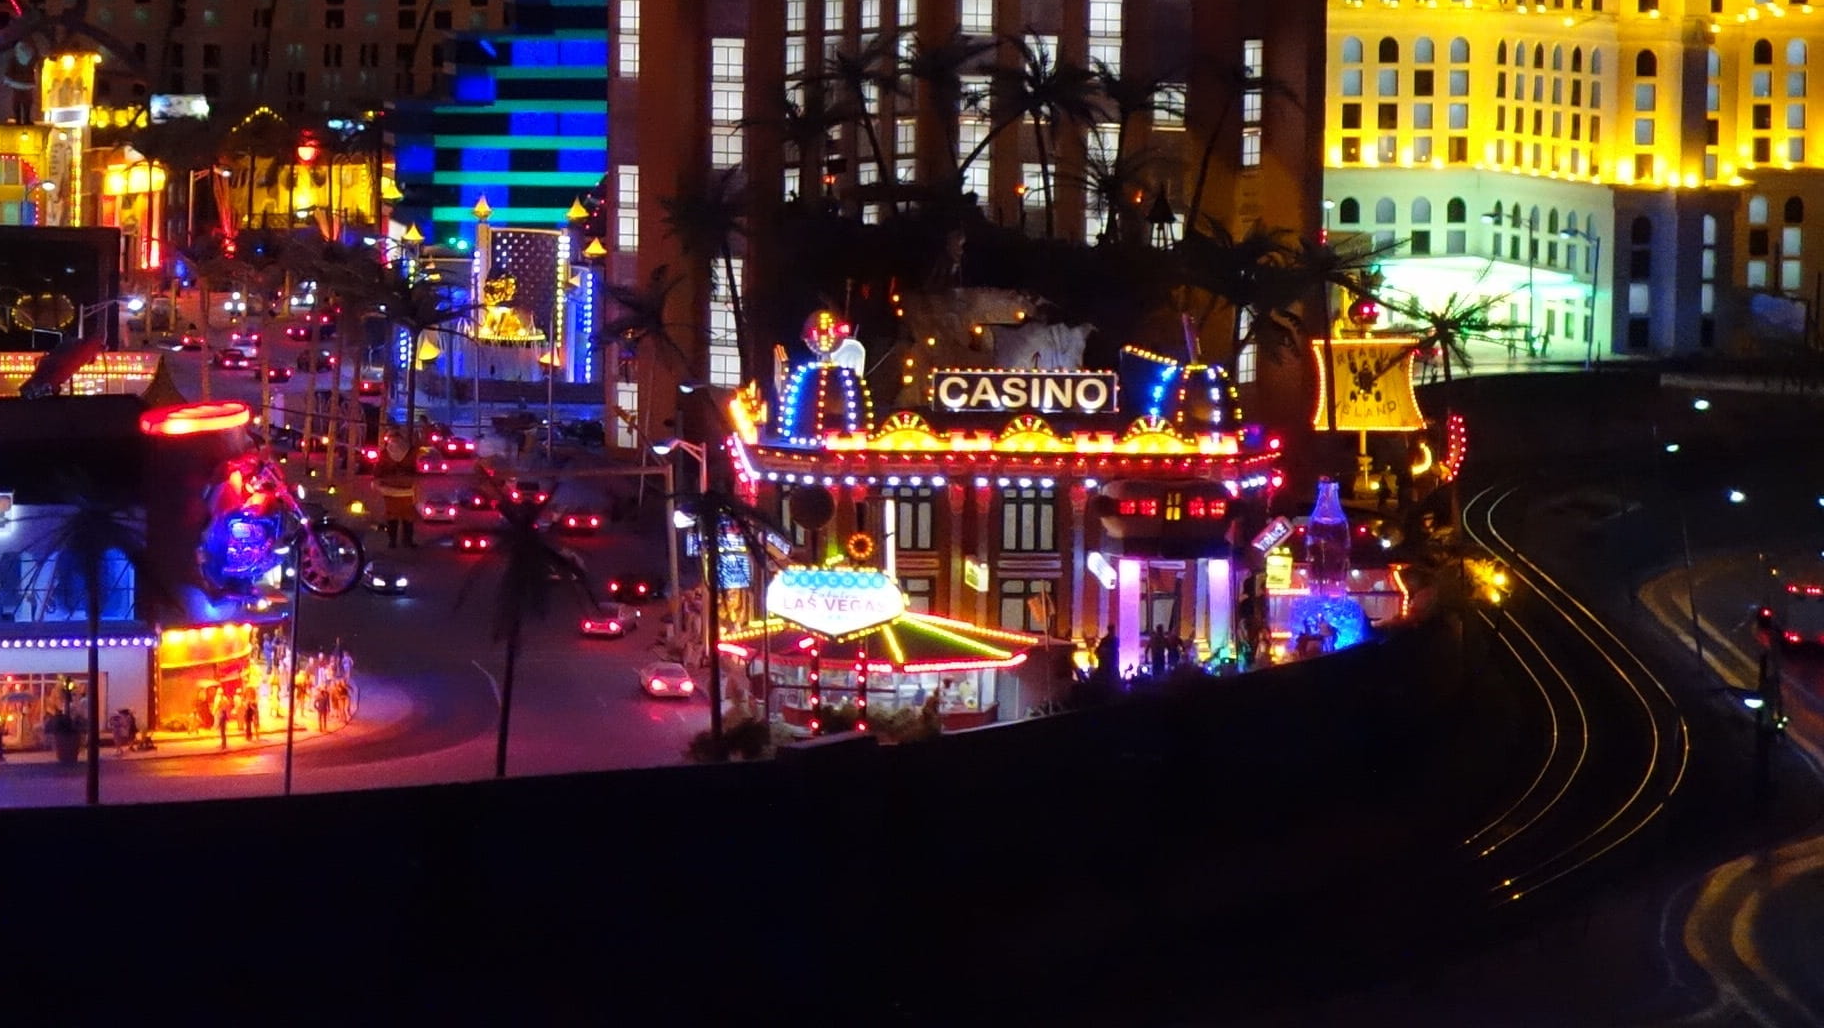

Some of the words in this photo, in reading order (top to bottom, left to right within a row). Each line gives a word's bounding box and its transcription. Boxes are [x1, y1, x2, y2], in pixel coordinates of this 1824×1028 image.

[938, 376, 1108, 410] CASINO
[784, 572, 884, 587] WELCOME
[783, 595, 817, 610] LAS
[824, 597, 885, 612] VEGAS
